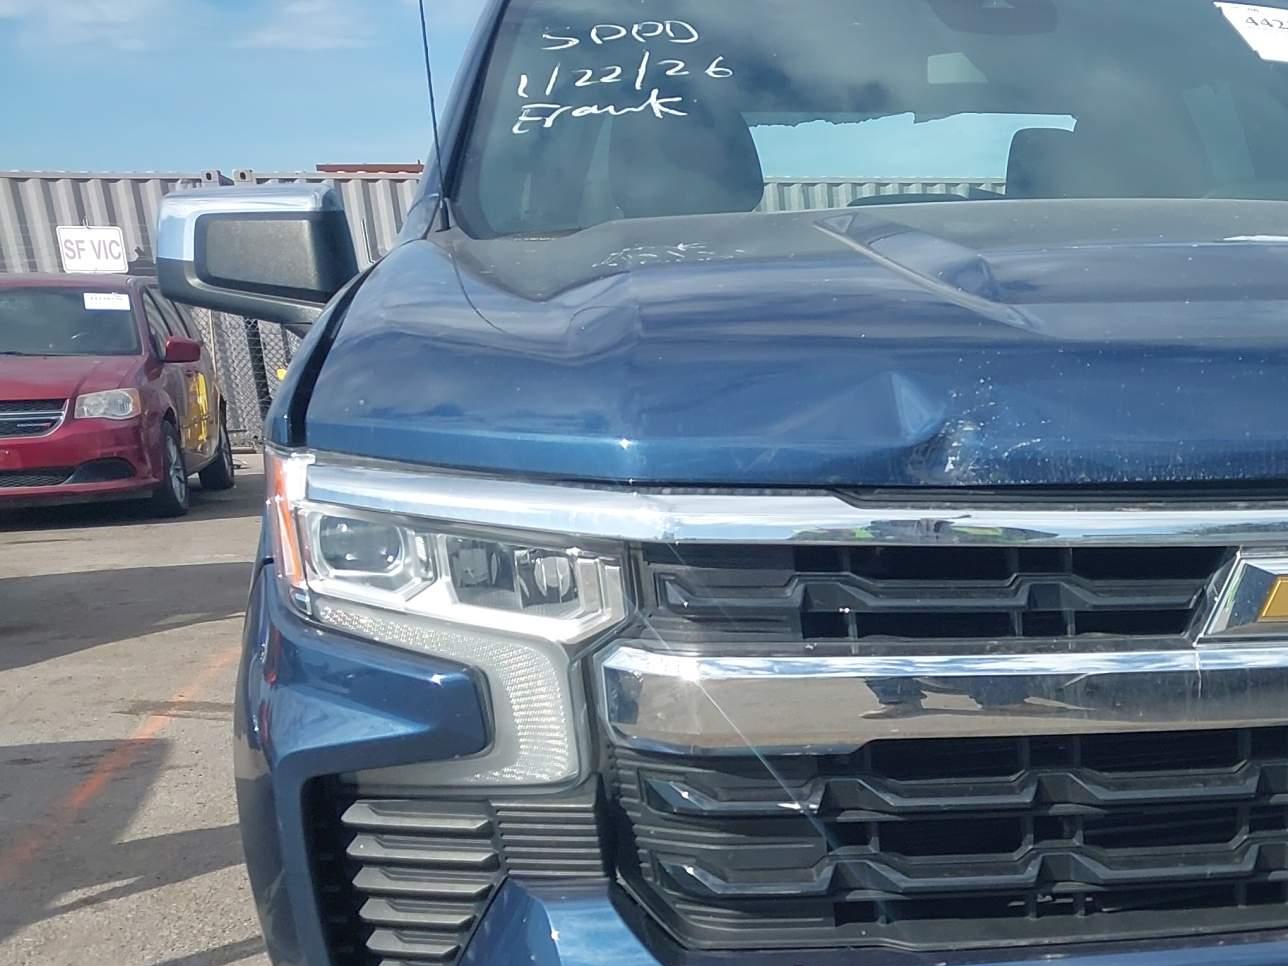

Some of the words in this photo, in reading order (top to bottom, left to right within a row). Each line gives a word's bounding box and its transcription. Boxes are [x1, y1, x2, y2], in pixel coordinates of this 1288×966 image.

[517, 51, 734, 98] 1/22/26
[64, 239, 87, 260] SF
[90, 239, 122, 260] VIC
